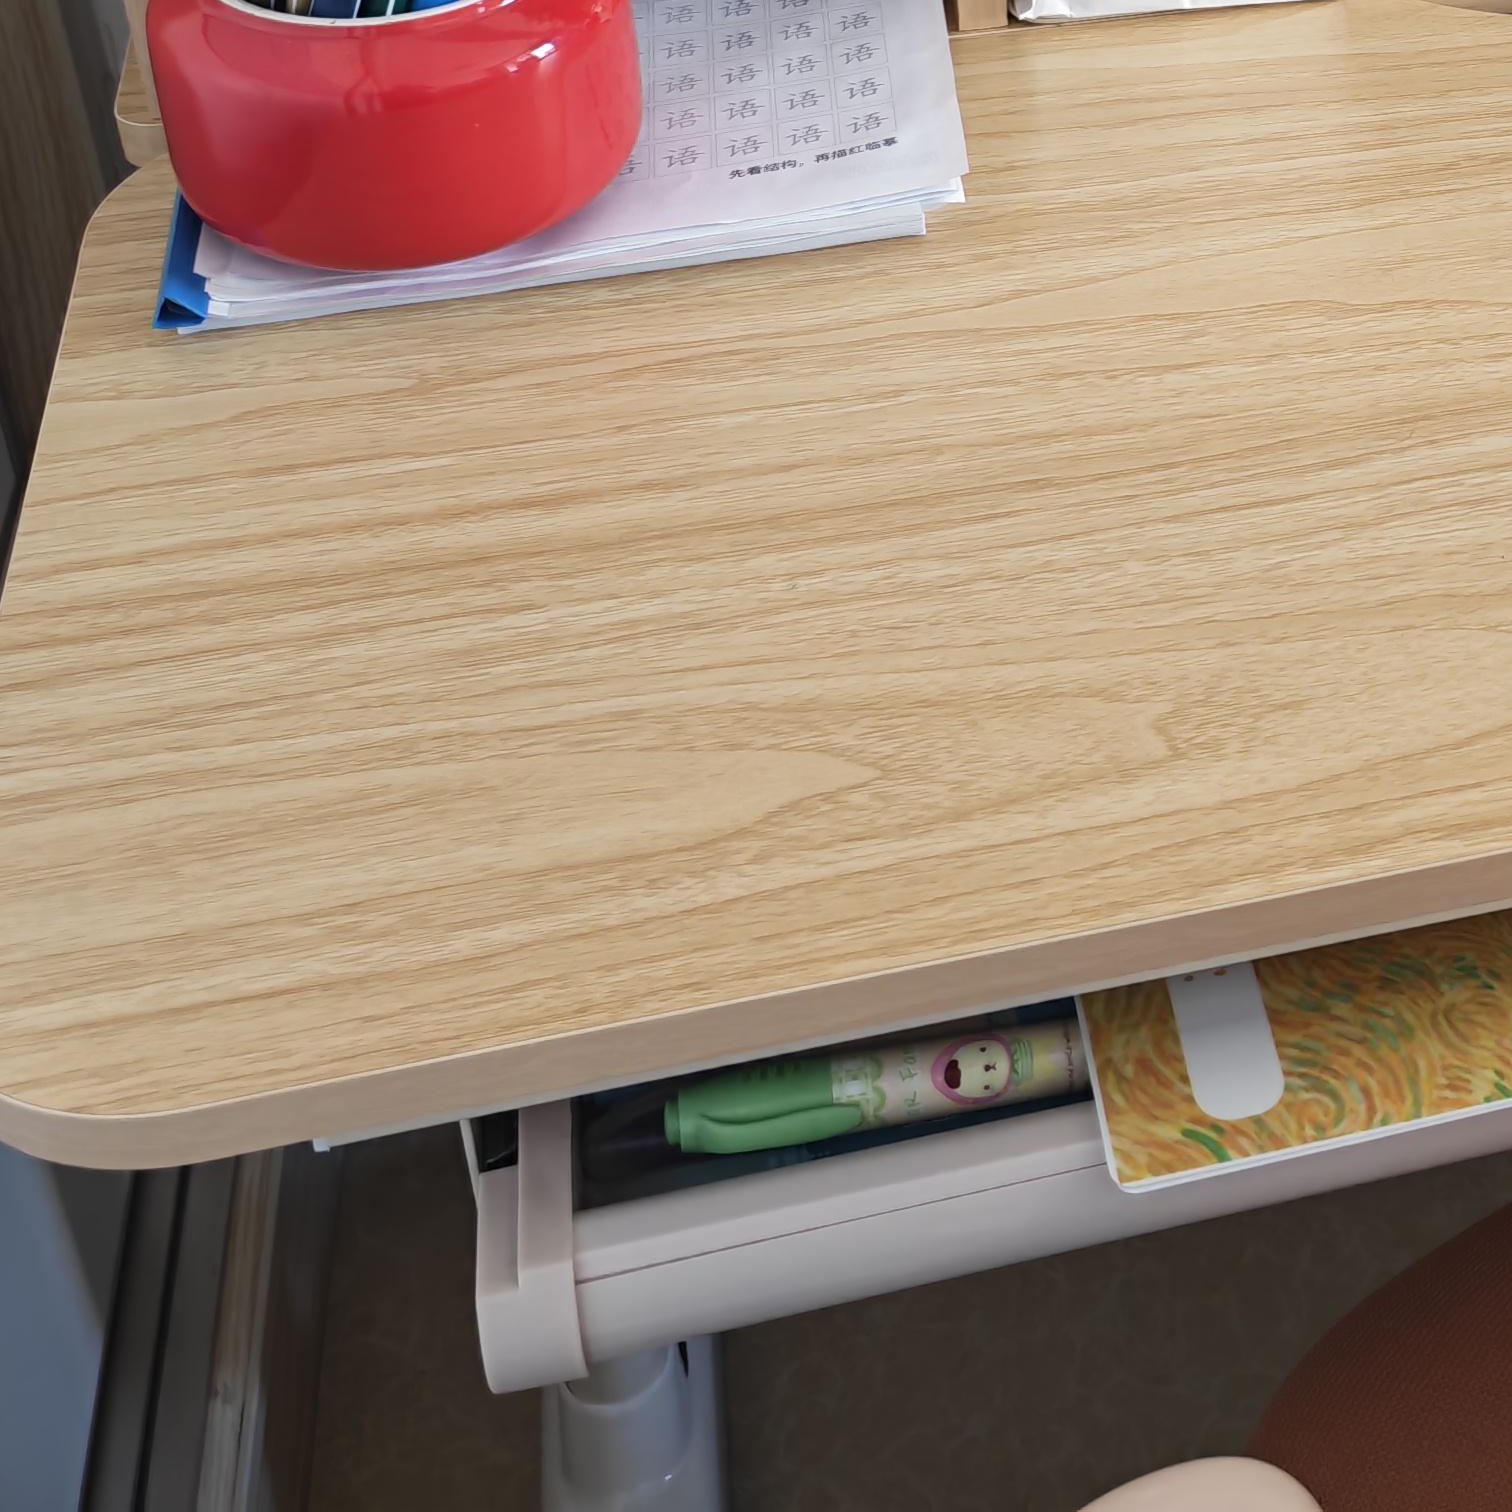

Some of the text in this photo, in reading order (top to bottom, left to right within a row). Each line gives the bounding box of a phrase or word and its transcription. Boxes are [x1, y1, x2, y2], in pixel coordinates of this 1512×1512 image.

[661, 5, 701, 23] 语
[661, 12, 876, 59] 语 语 语 语
[662, 43, 880, 93] 语 语 语 语
[661, 78, 884, 130] 语 语 语 语
[662, 112, 888, 167] 语 语 语 语
